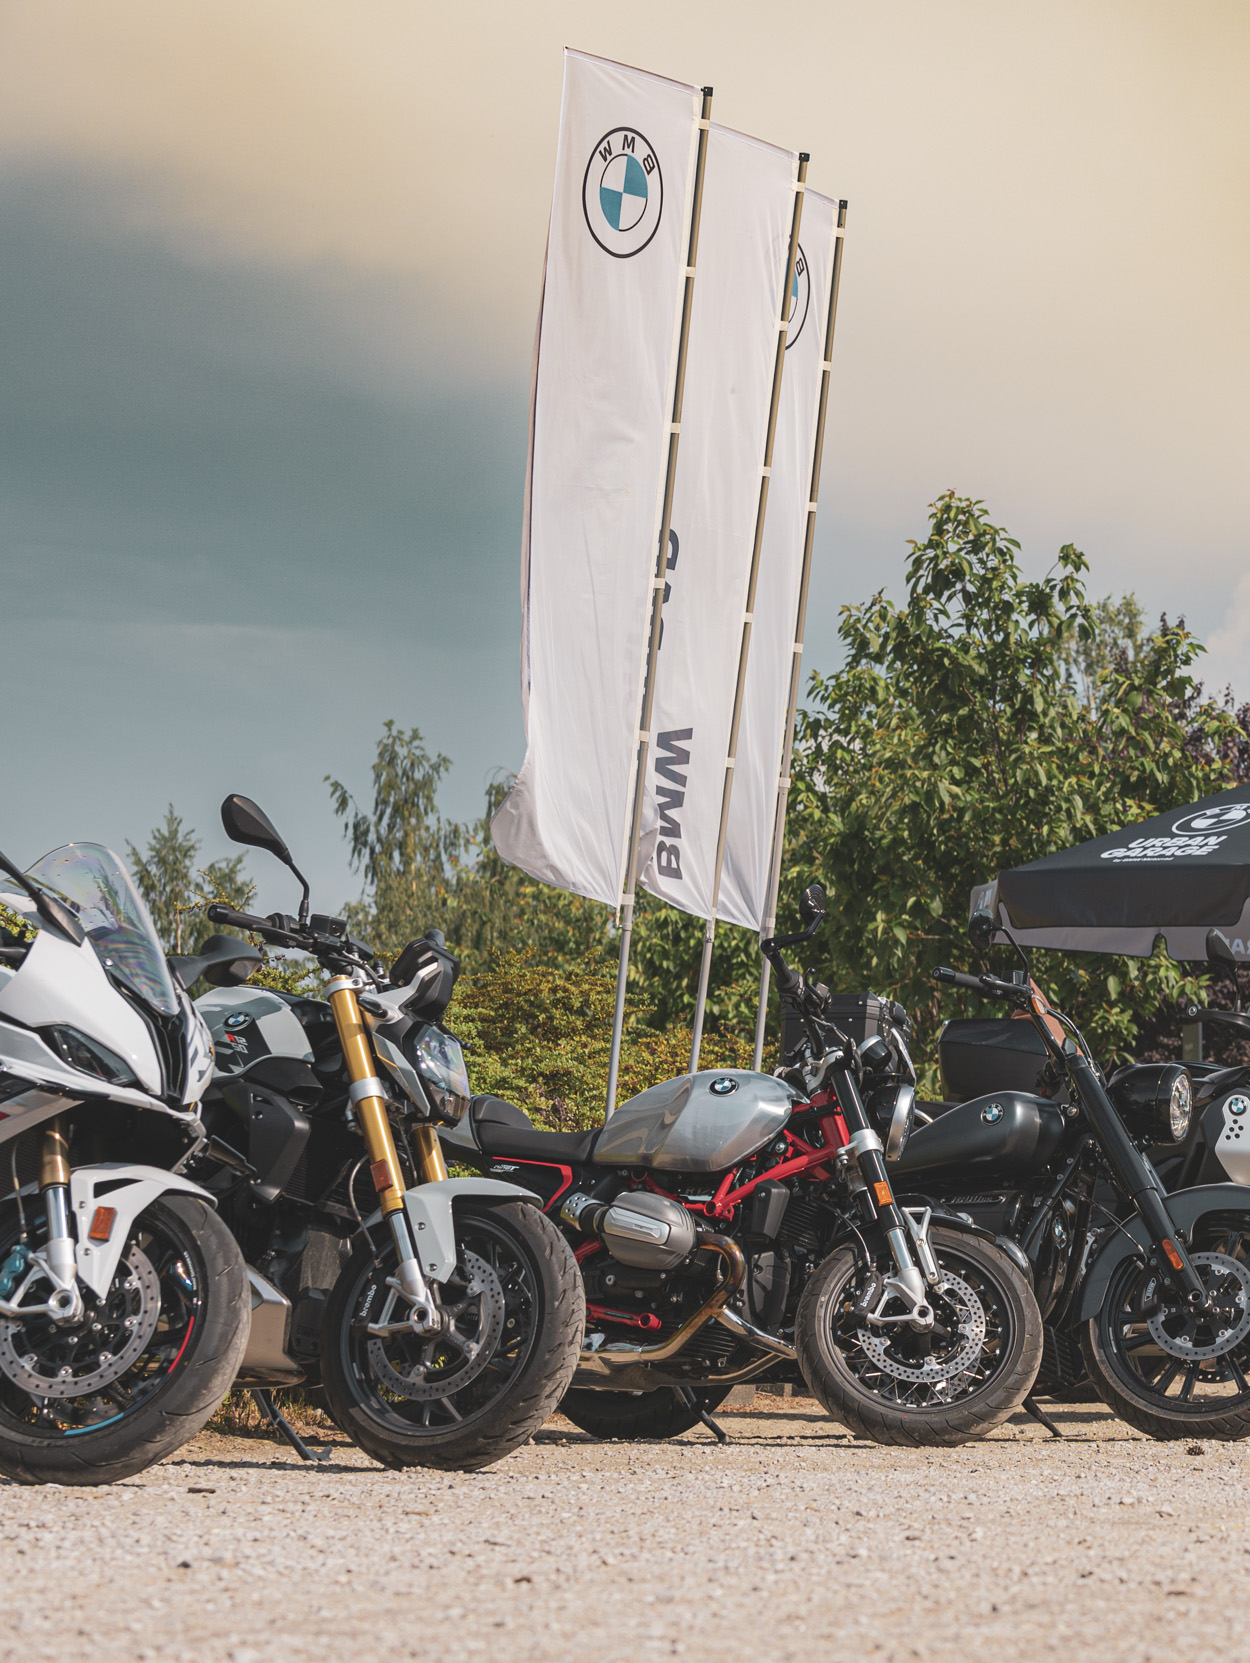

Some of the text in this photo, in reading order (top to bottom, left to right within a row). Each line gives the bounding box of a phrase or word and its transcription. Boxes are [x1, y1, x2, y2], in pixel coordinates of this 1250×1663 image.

[1127, 835, 1228, 848] URBAN
[1100, 845, 1220, 859] GARAGE
[359, 1284, 377, 1318] brembo
[859, 1282, 877, 1308] brembo
